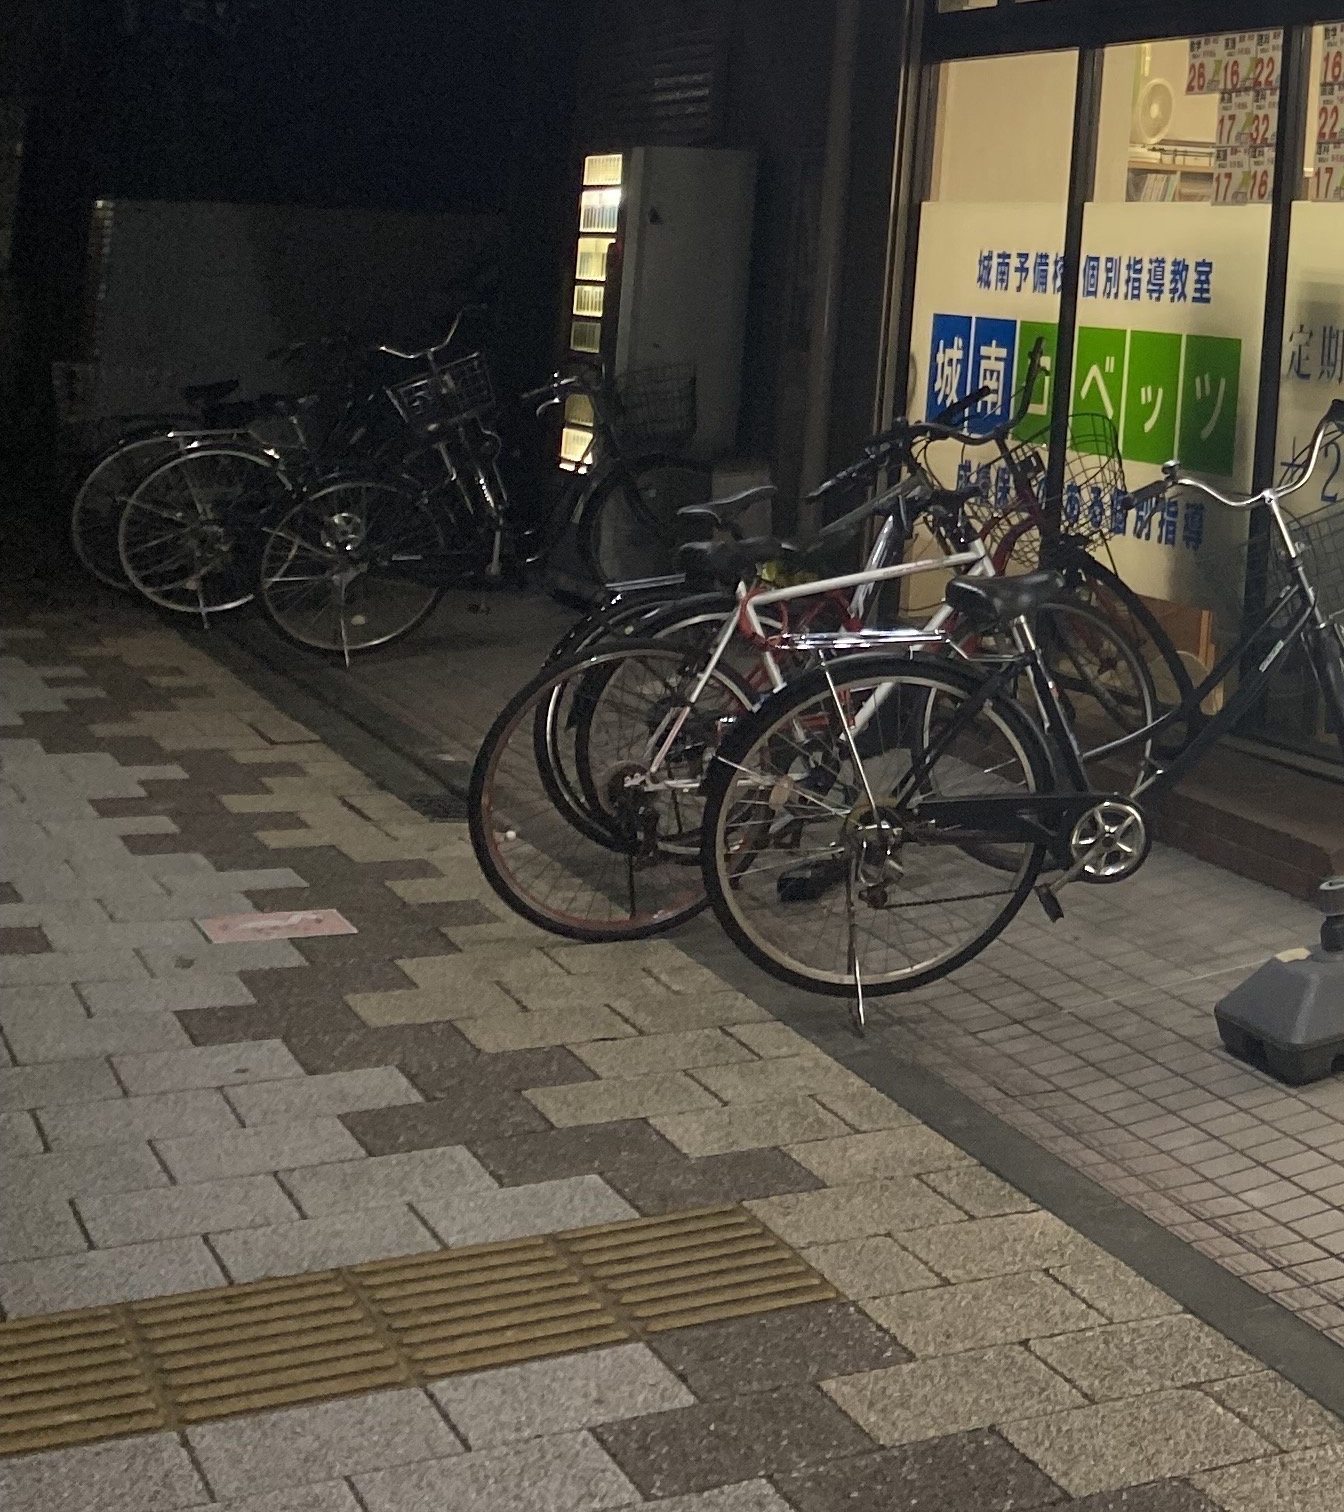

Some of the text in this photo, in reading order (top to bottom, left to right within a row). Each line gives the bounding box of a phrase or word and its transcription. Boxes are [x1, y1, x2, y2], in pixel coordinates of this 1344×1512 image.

[1082, 254, 1215, 305] 個別指導教室
